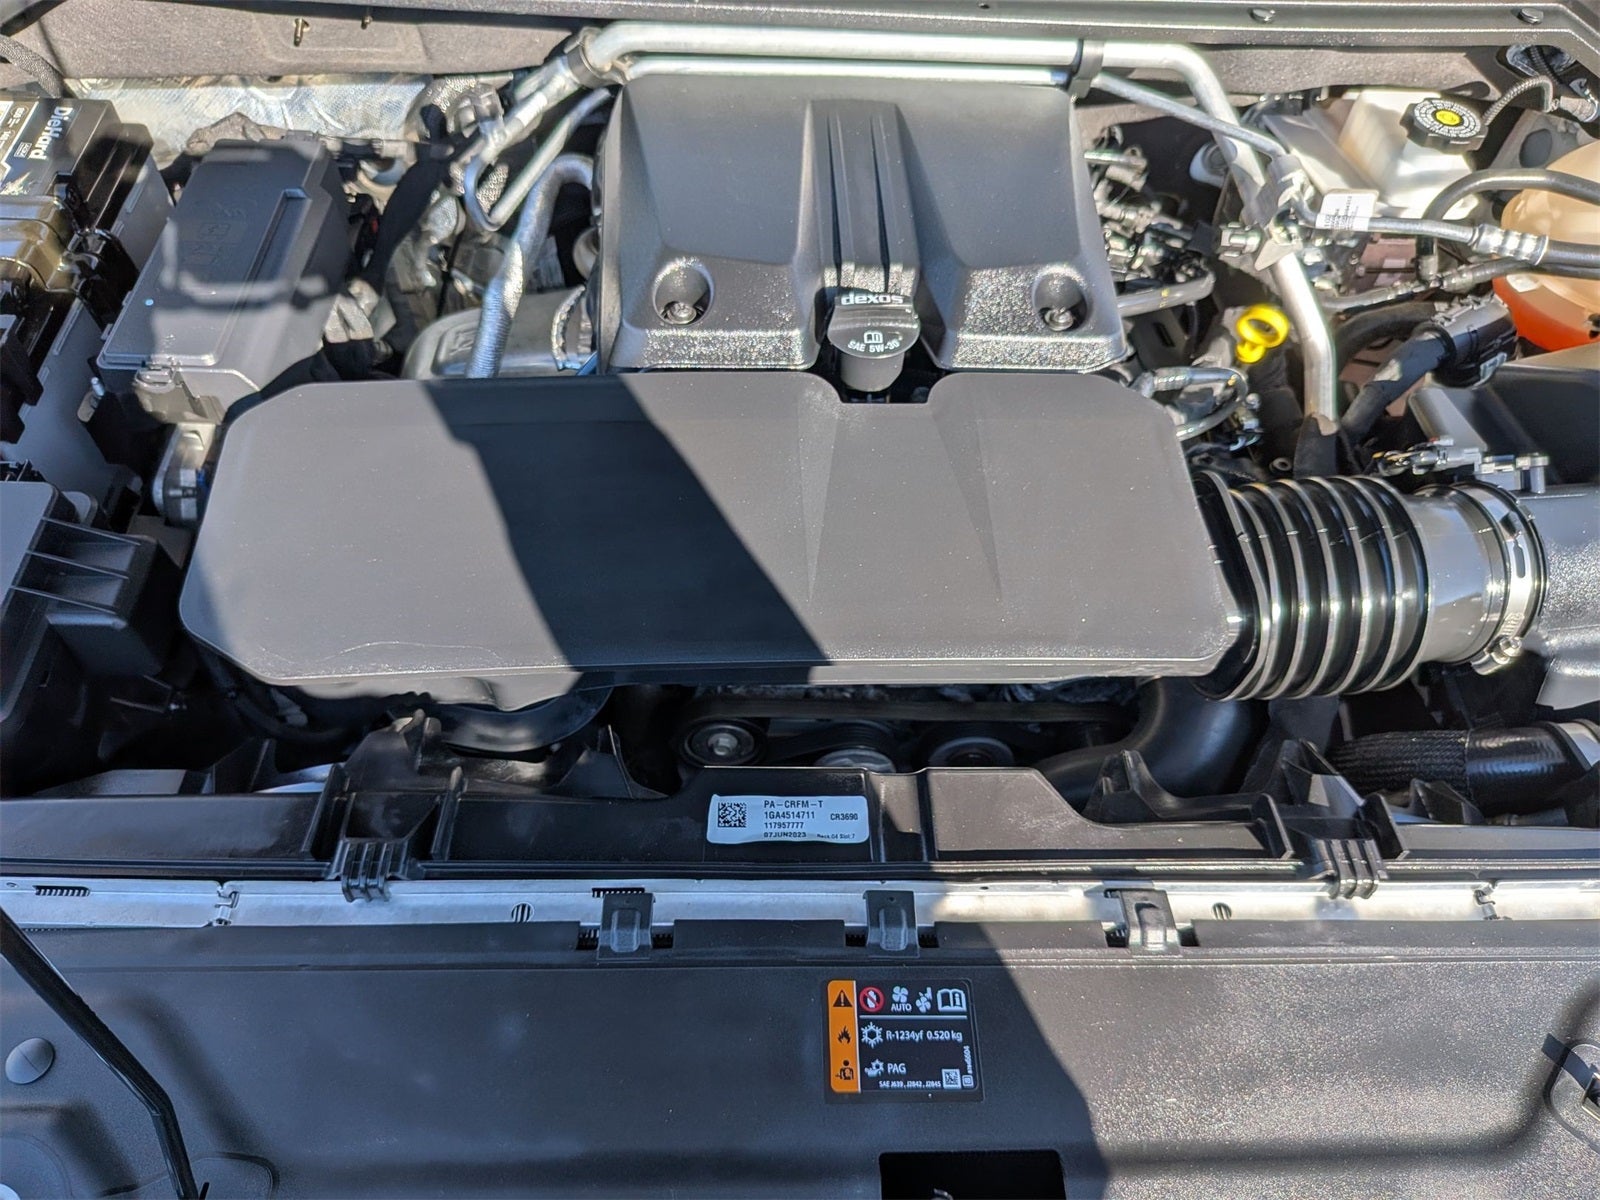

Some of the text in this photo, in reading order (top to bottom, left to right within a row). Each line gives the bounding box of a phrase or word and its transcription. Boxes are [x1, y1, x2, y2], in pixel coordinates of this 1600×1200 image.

[28, 106, 73, 160] DieHard
[841, 292, 903, 305] dexos
[848, 339, 901, 353] SAE 5W-30
[763, 811, 815, 820] 1GA4514711
[830, 813, 859, 821] CR3690
[763, 822, 804, 830] 117957777
[891, 1003, 912, 1012] AUTO
[886, 1029, 963, 1043] R-1234yf 0.520 kg
[887, 1063, 907, 1074] PAG
